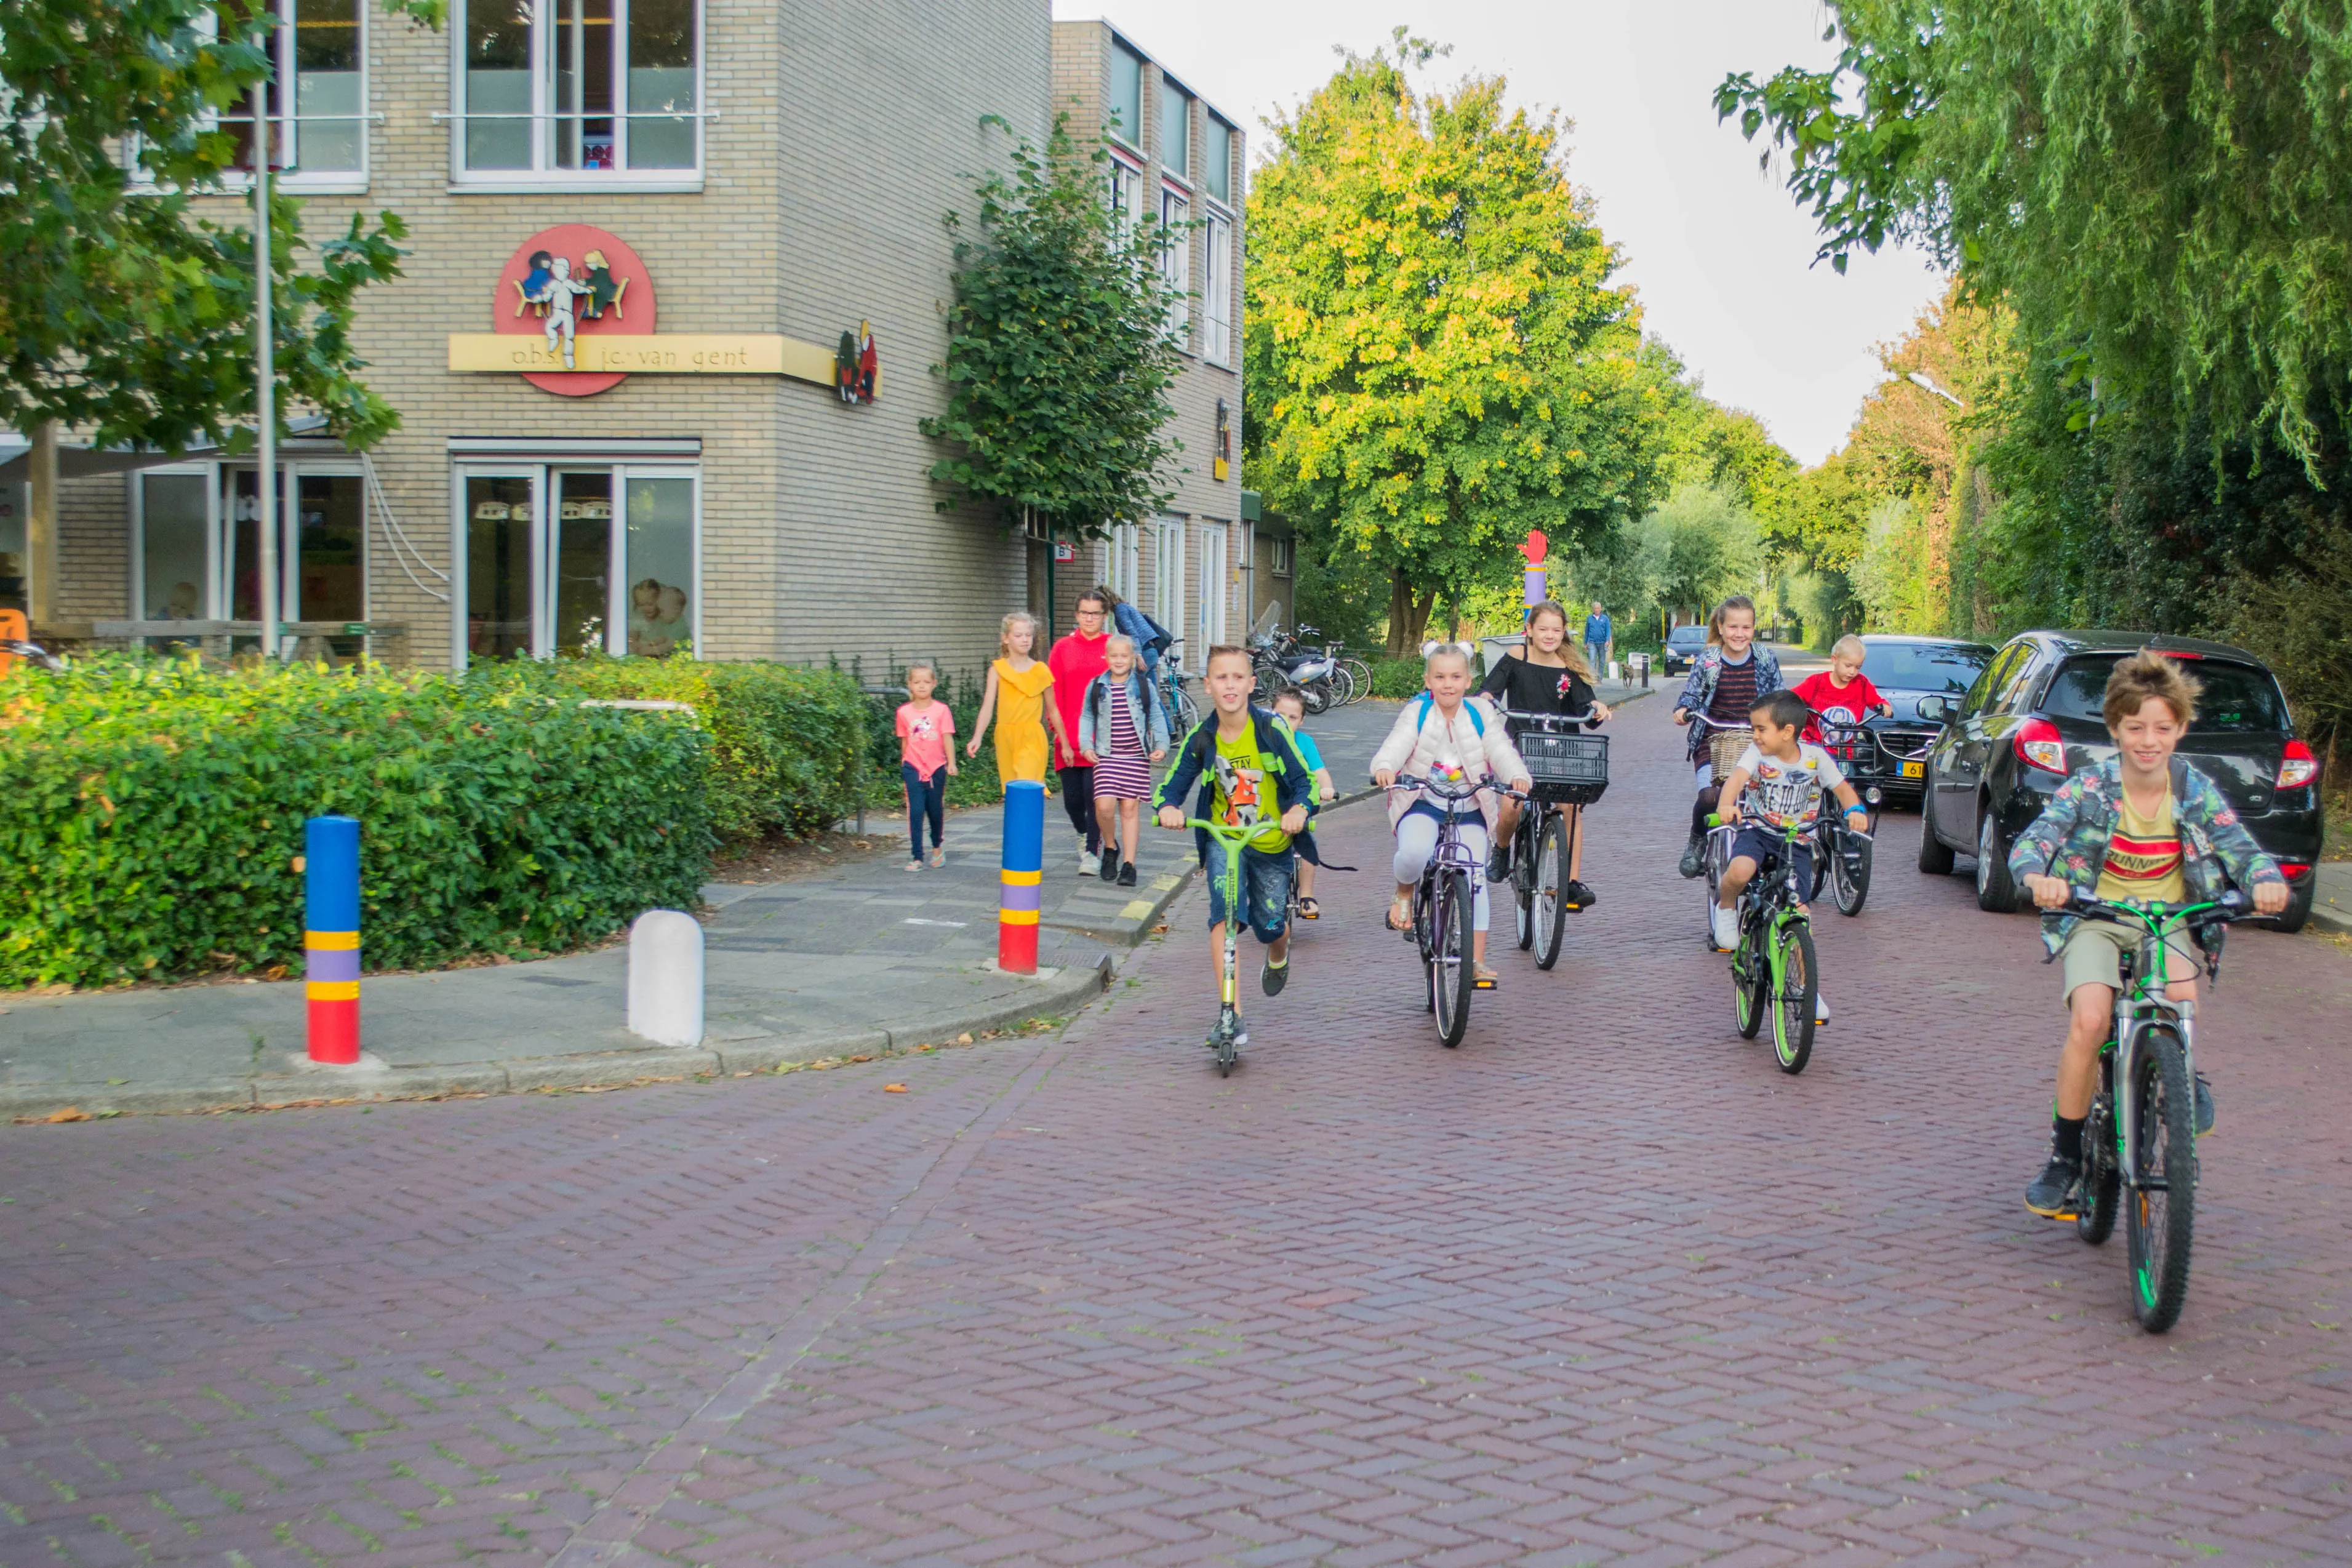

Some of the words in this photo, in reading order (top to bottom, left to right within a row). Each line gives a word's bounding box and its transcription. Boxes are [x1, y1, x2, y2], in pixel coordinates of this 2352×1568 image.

[638, 351, 677, 366] van
[692, 346, 748, 370] gent
[1230, 758, 1250, 769] STAY
[1779, 785, 1794, 814] TO
